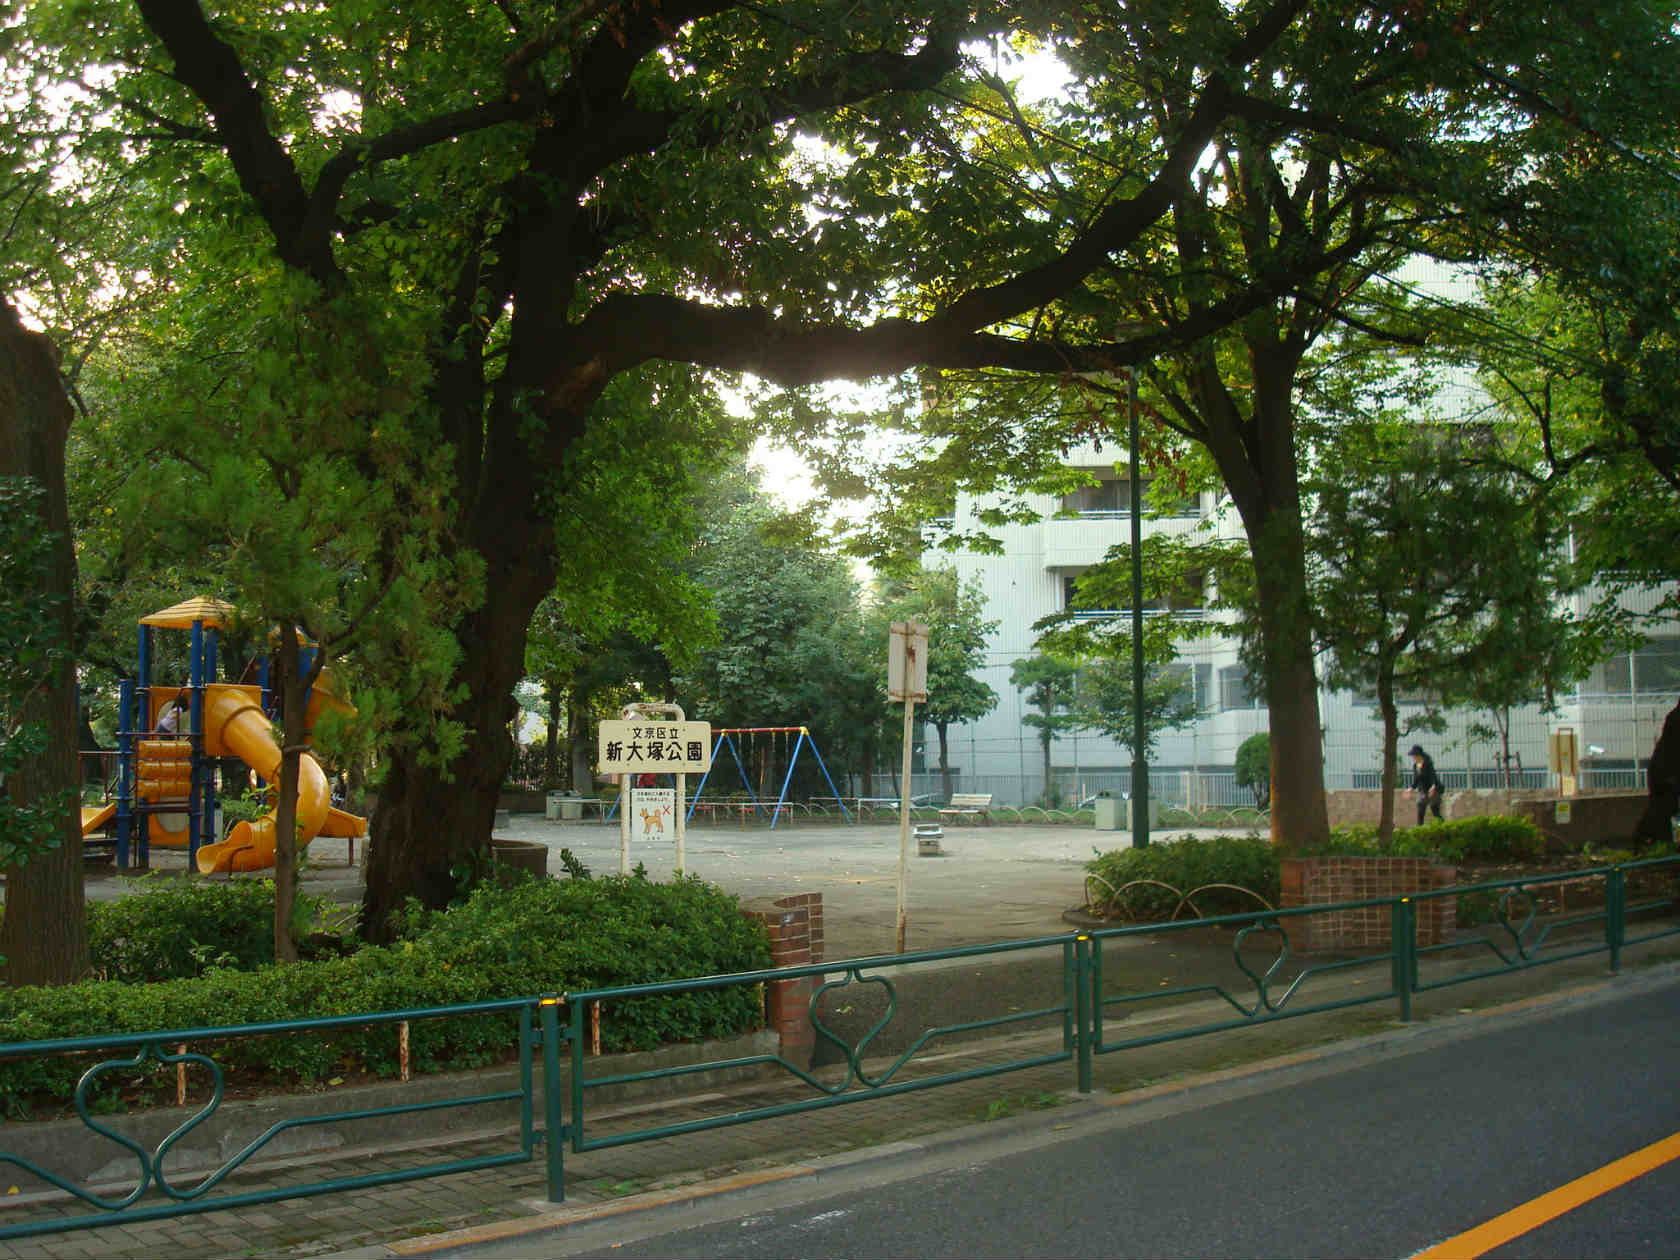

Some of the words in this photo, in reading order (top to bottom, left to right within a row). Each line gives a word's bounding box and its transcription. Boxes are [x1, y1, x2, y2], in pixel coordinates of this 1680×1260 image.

[632, 727, 680, 739] 文京区立
[606, 741, 702, 761] 新大塚公園
